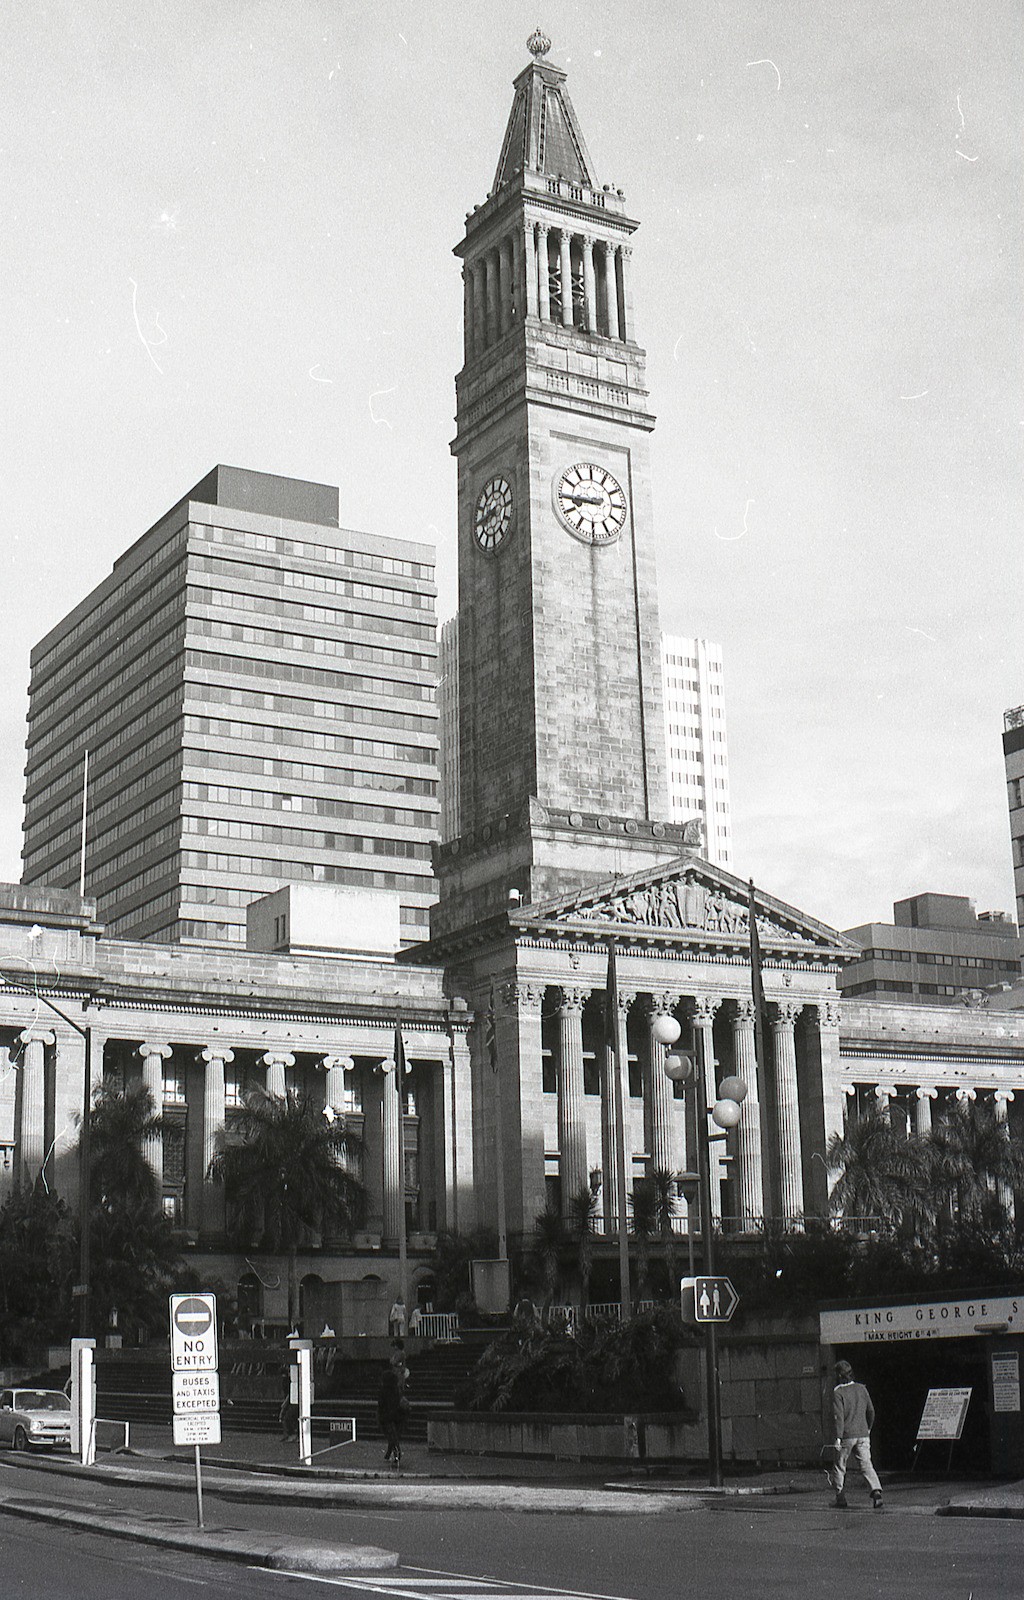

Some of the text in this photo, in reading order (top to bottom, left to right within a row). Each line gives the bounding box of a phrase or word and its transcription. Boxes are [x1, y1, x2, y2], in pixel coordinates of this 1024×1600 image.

[855, 1311, 894, 1325] KING
[916, 1304, 988, 1321] GEORGE
[868, 1332, 885, 1340] MAX
[887, 1331, 913, 1340] HEIGHT
[184, 1340, 205, 1352] NO
[176, 1355, 213, 1366] ENTRY
[182, 1377, 210, 1386] BUSES
[193, 1388, 216, 1396] TAXIS
[176, 1399, 217, 1409] EXCEPTED
